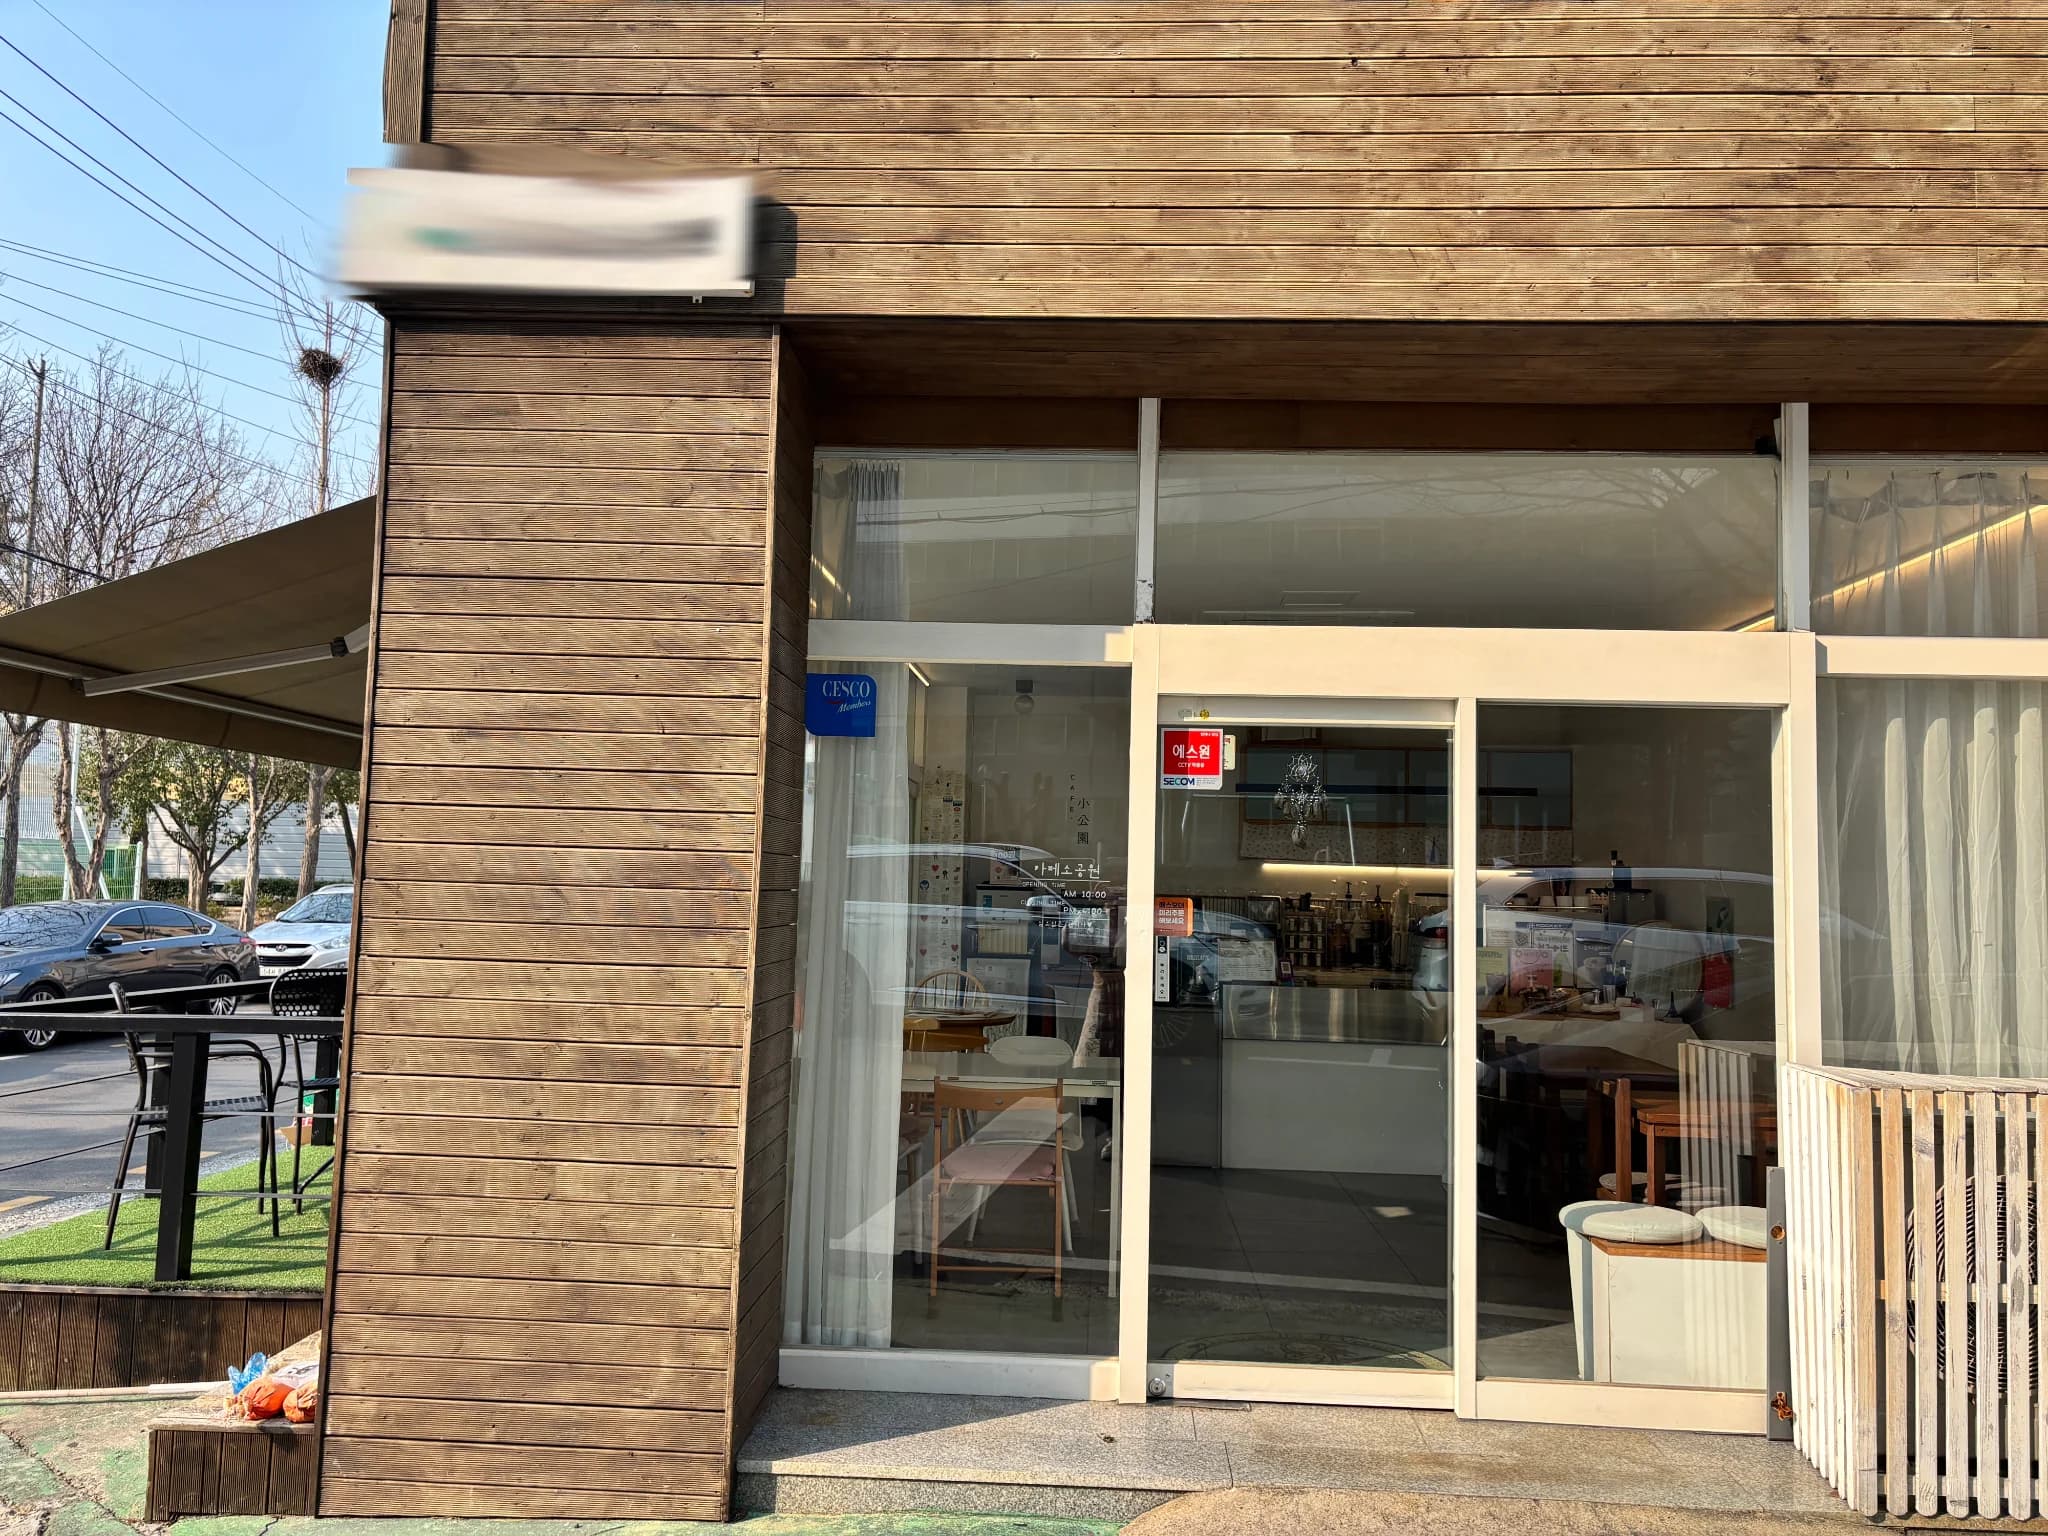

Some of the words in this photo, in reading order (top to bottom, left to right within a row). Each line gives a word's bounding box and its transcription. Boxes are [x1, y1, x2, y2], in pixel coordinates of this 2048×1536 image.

[822, 680, 870, 698] CESCO
[837, 698, 872, 713] Members
[1172, 744, 1210, 759] 에스원
[1163, 777, 1195, 786] SECOM
[1063, 890, 1077, 898] AM
[1081, 890, 1107, 899] 10:00
